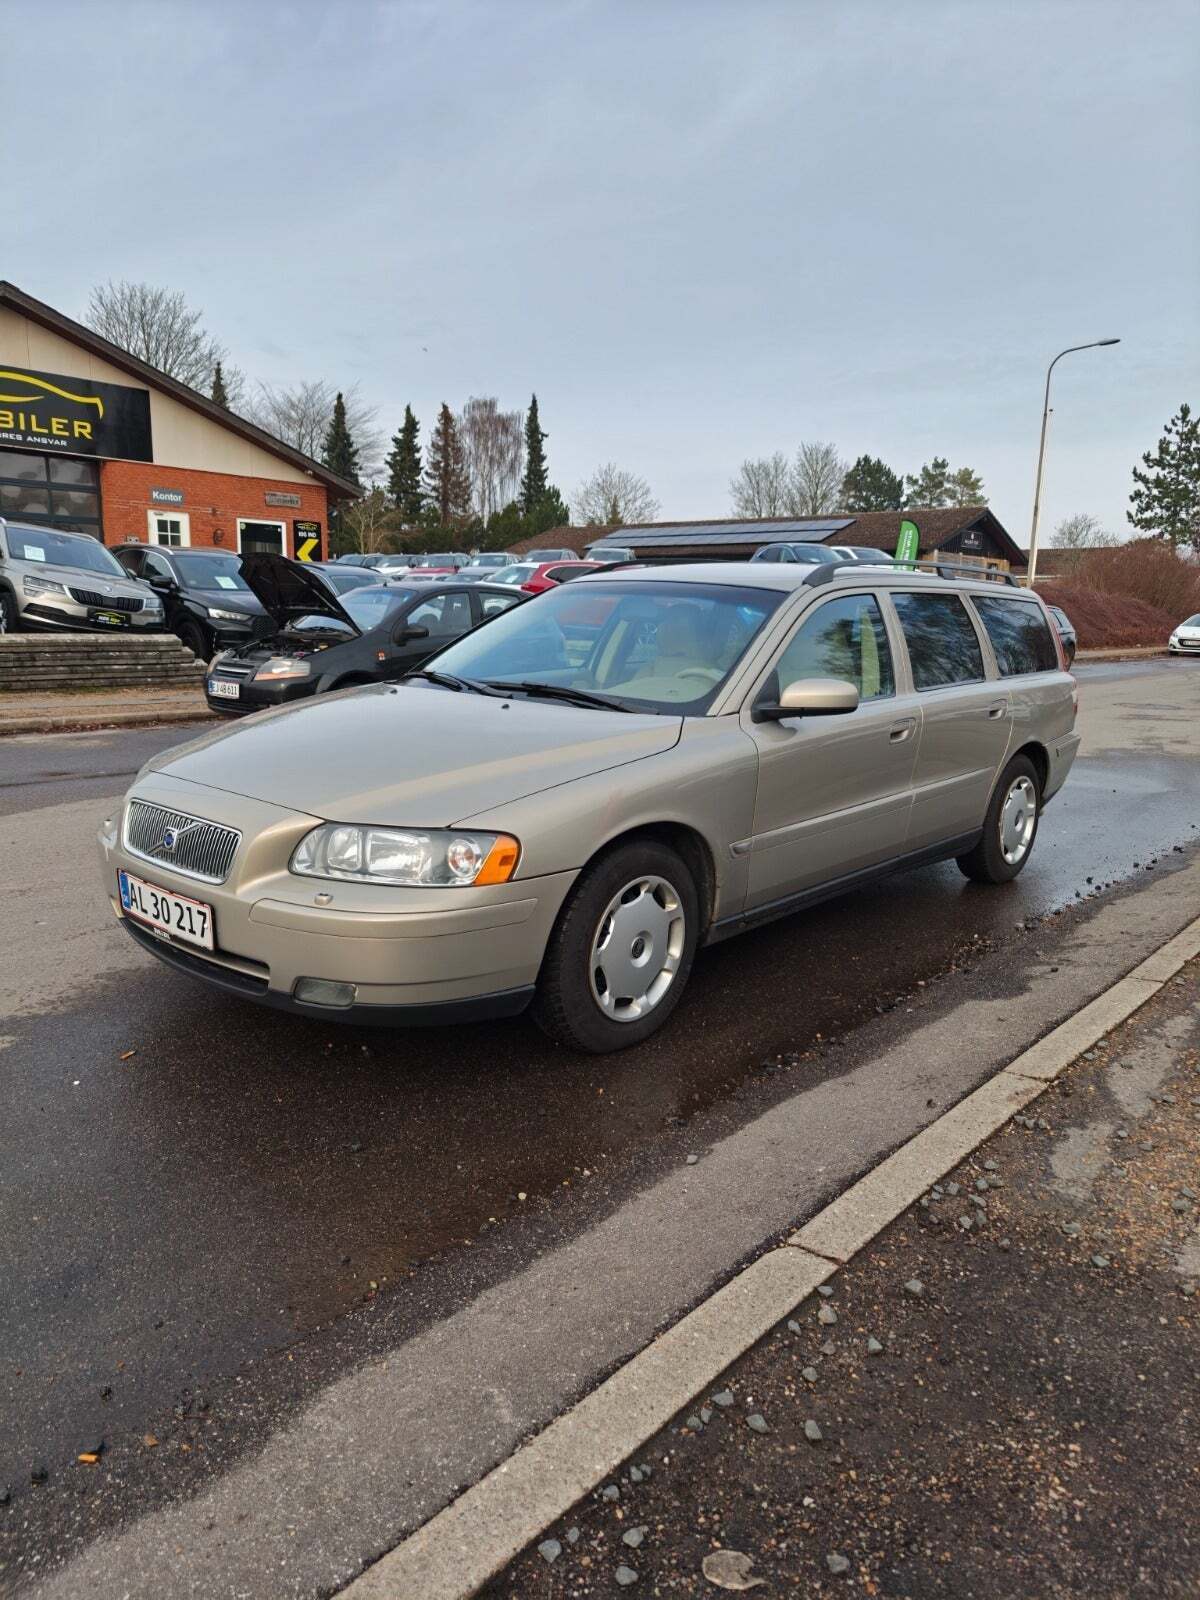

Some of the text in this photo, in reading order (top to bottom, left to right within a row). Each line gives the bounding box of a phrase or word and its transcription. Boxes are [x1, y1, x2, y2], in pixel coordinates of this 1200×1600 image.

[26, 435, 68, 447] ANSVAR
[152, 490, 183, 502] Kontor
[227, 685, 237, 695] 611
[130, 882, 207, 938] AL 30 217
